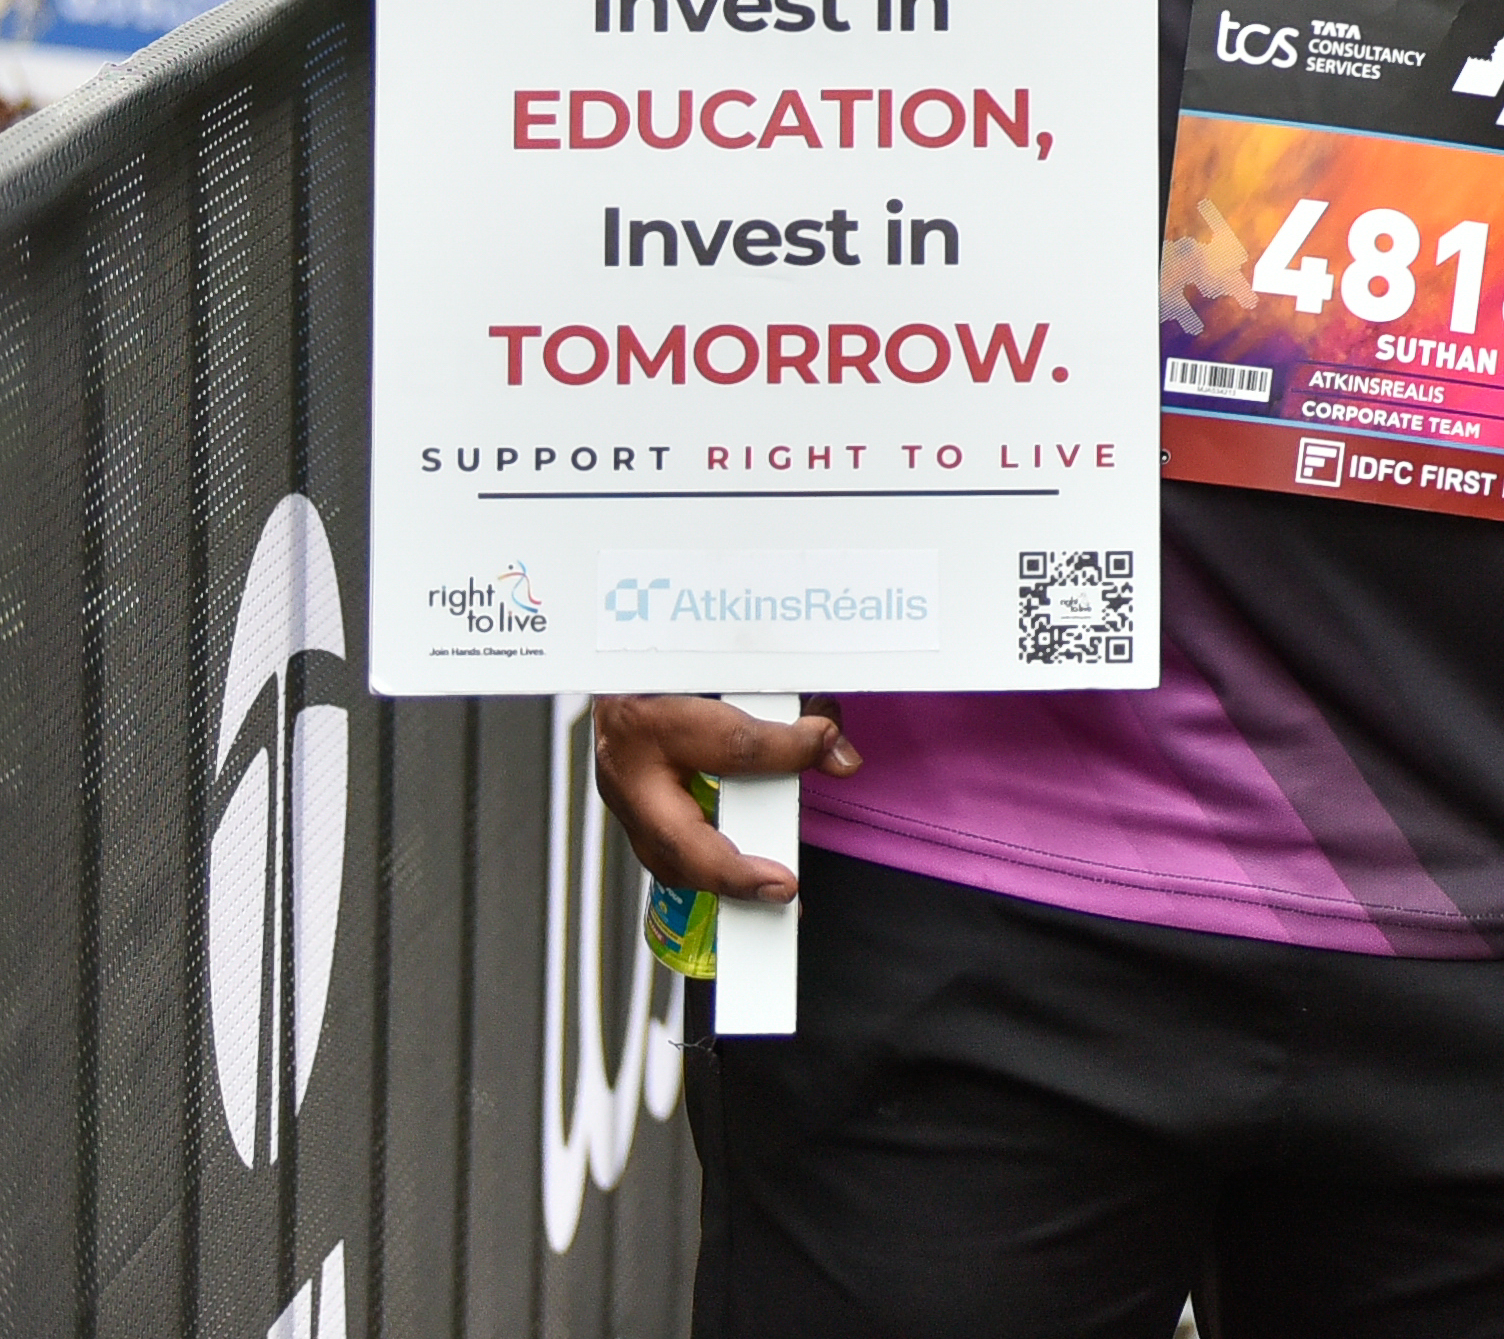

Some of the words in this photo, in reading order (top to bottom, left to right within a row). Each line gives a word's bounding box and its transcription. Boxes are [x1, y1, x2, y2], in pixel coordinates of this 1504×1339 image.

[1216, 9, 1299, 69] tcs
[1311, 19, 1361, 40] TATA
[1305, 56, 1381, 81] SERVICES
[1307, 39, 1426, 68] CONSULTANCY
[510, 88, 1054, 162] EDUCATION,
[602, 207, 858, 268] Invest
[886, 200, 961, 266] in
[488, 320, 1070, 388] TOMORROW.
[1375, 333, 1499, 375] SUTHAN
[1308, 369, 1445, 404] ATKINSREALIS
[1301, 400, 1424, 431] CORPORATE
[1428, 416, 1481, 439] TEAM
[421, 446, 673, 473] SUPPORT
[705, 444, 870, 472] RIGHT
[902, 444, 965, 471] TO
[999, 443, 1118, 470] LIVE
[1349, 452, 1414, 483] IDFC
[1419, 460, 1497, 497] FIRST
[429, 576, 495, 616] right
[670, 587, 928, 622] AtkinsRéalis
[467, 608, 494, 632] to
[499, 602, 548, 632] live
[429, 647, 449, 656] Join
